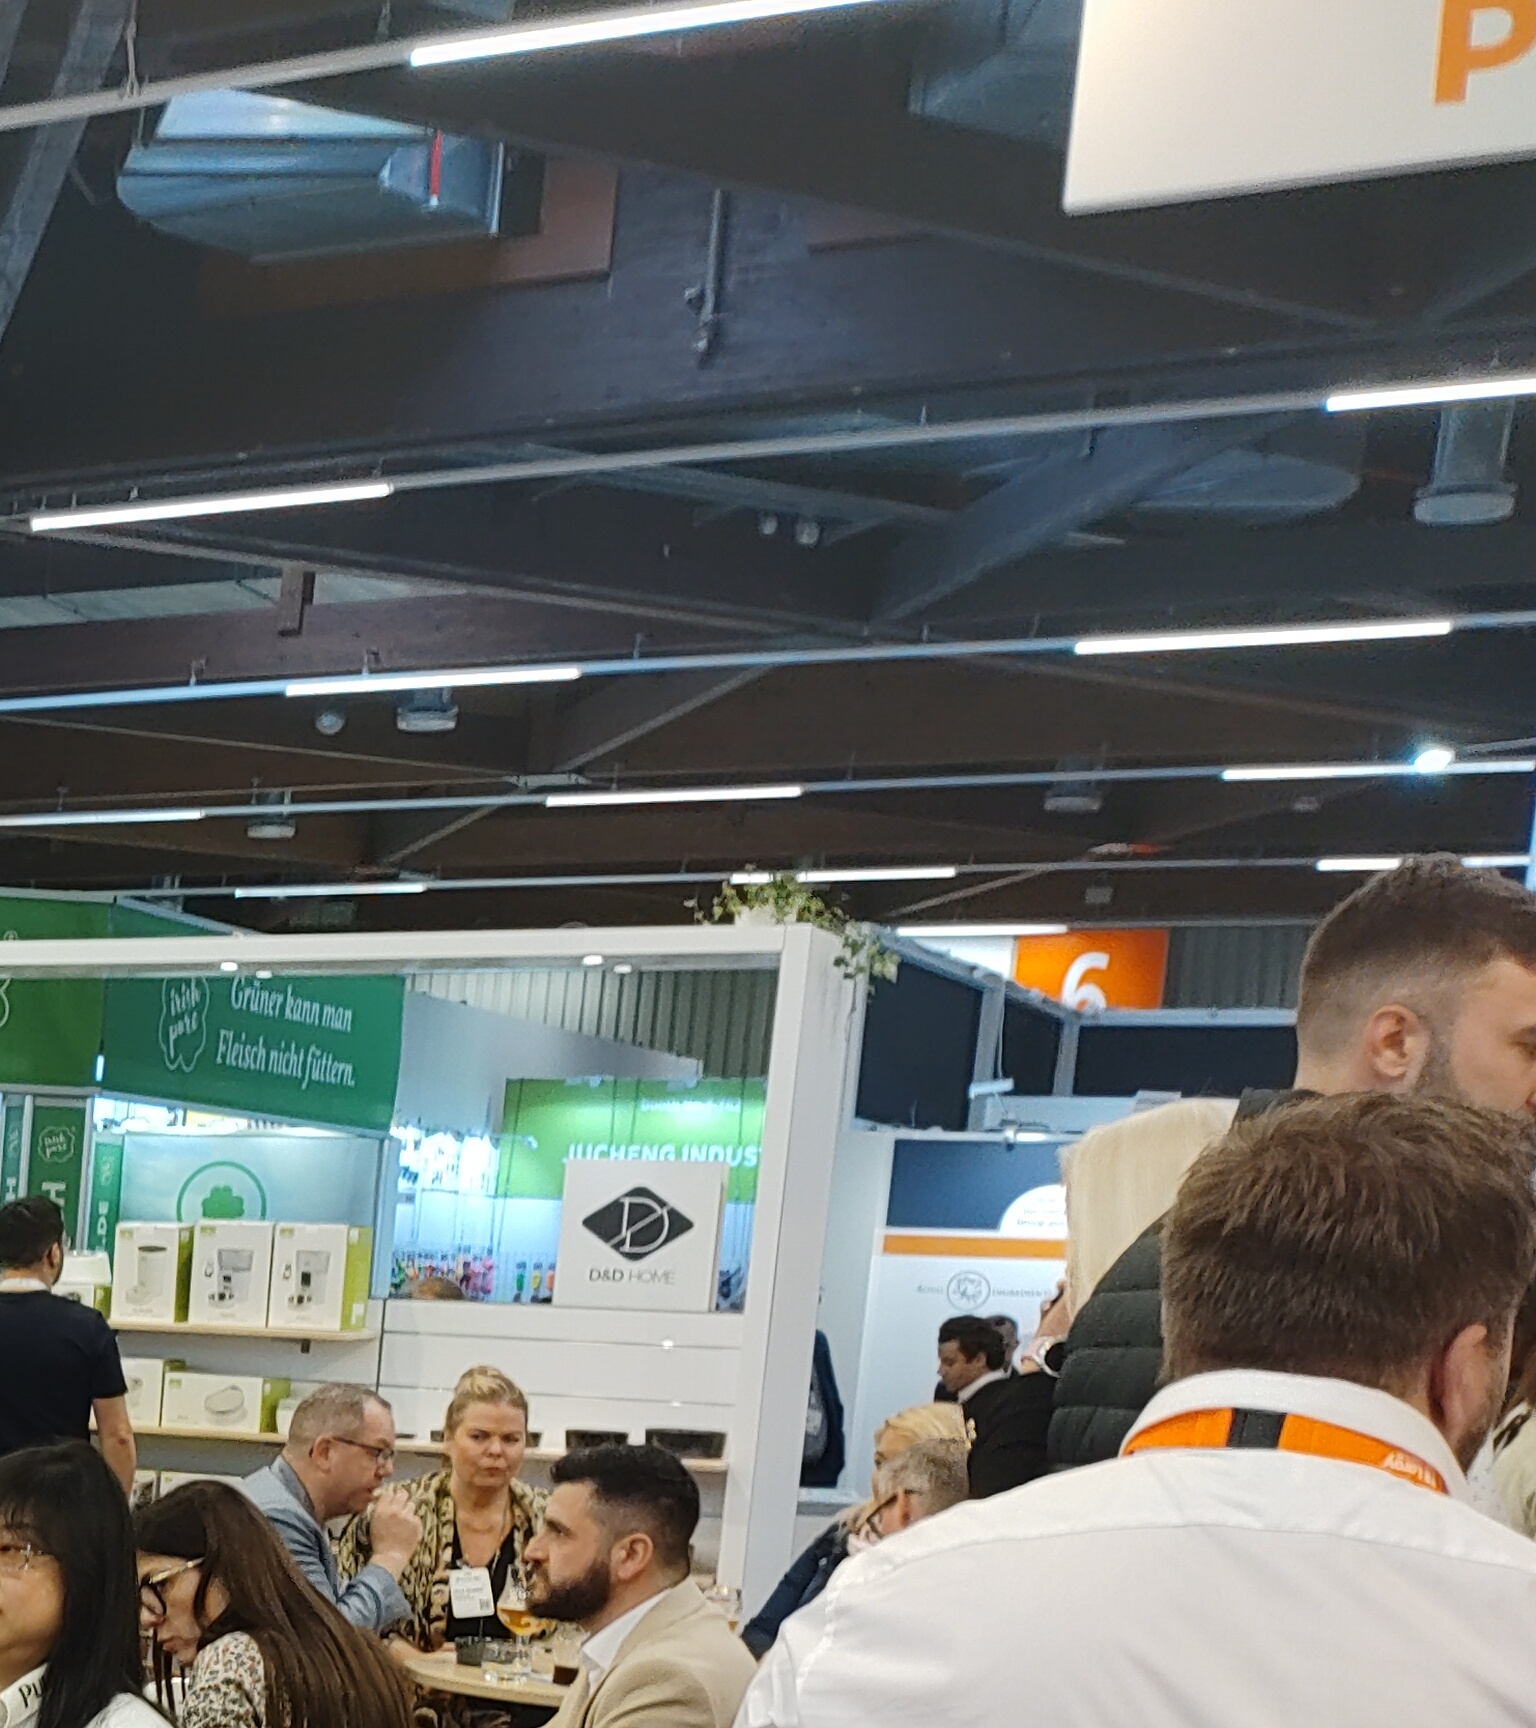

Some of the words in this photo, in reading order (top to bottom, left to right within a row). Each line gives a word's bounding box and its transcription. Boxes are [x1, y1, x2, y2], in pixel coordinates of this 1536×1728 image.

[230, 975, 284, 1019] Grüner
[284, 983, 320, 1026] kann
[321, 1004, 353, 1033] man
[1061, 951, 1110, 1016] 6
[215, 1028, 266, 1072] Fleisch
[268, 1039, 304, 1079] nicht
[301, 1042, 356, 1091] füttern.
[588, 1268, 624, 1282] D&D
[628, 1269, 676, 1285] HOME
